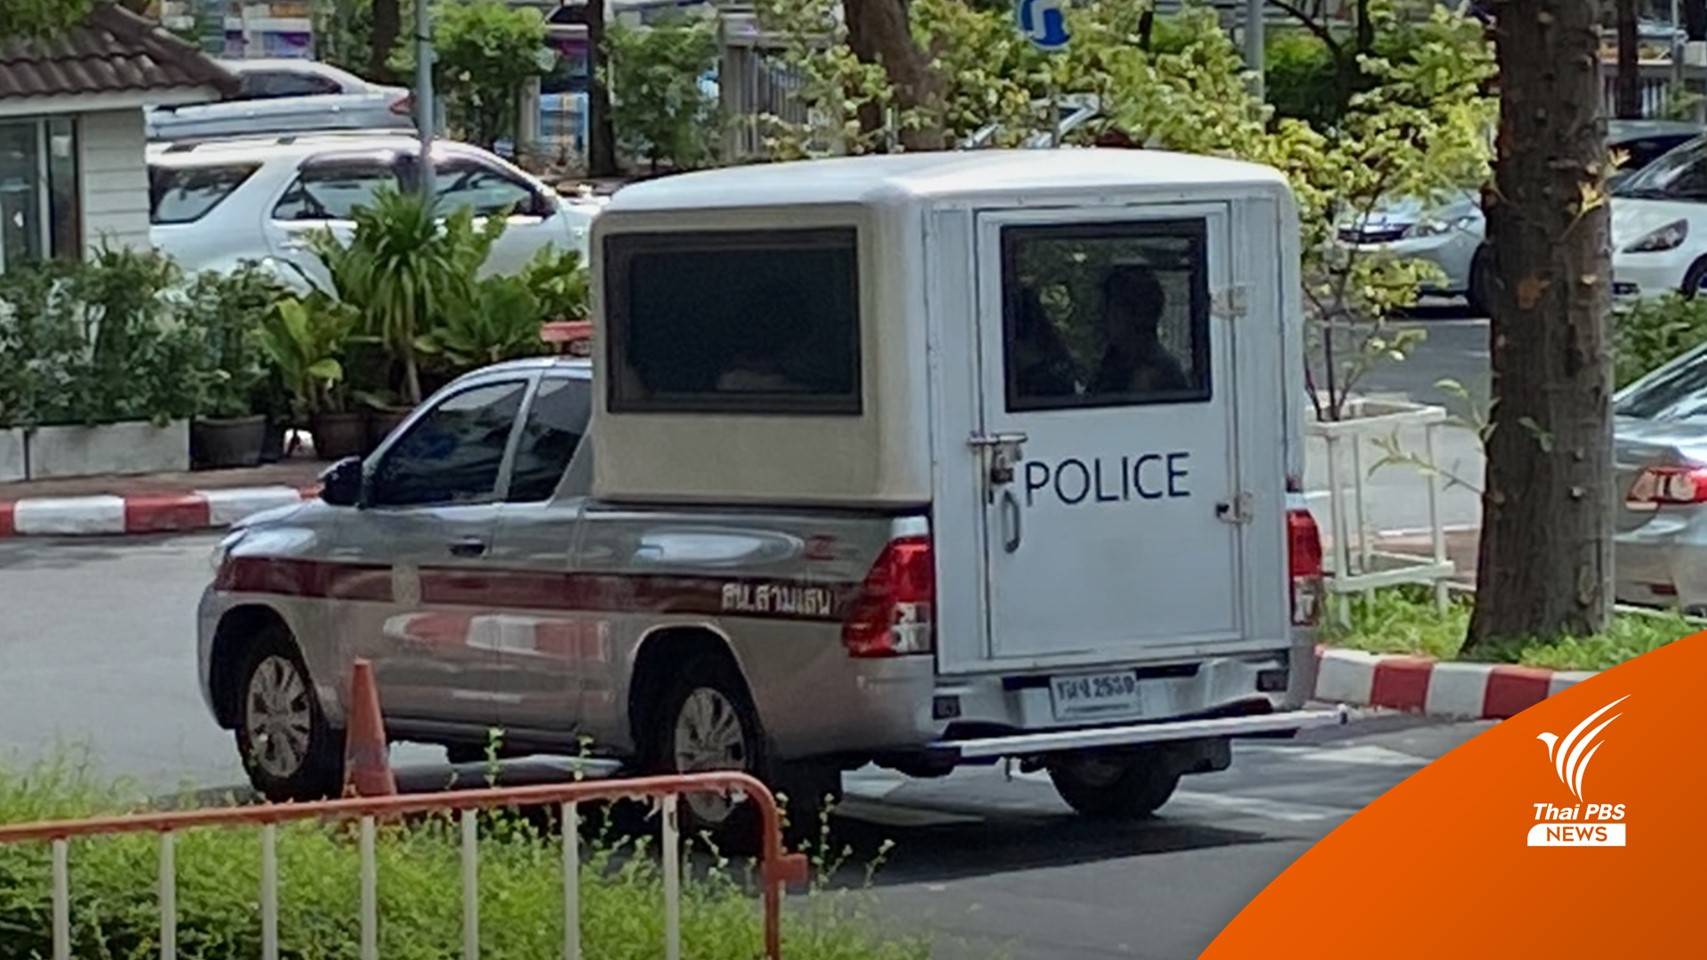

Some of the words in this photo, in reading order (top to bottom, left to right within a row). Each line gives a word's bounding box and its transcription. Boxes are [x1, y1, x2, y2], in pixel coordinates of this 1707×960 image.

[1025, 452, 1190, 507] POLICE
[721, 582, 831, 615] สน.สามเสน
